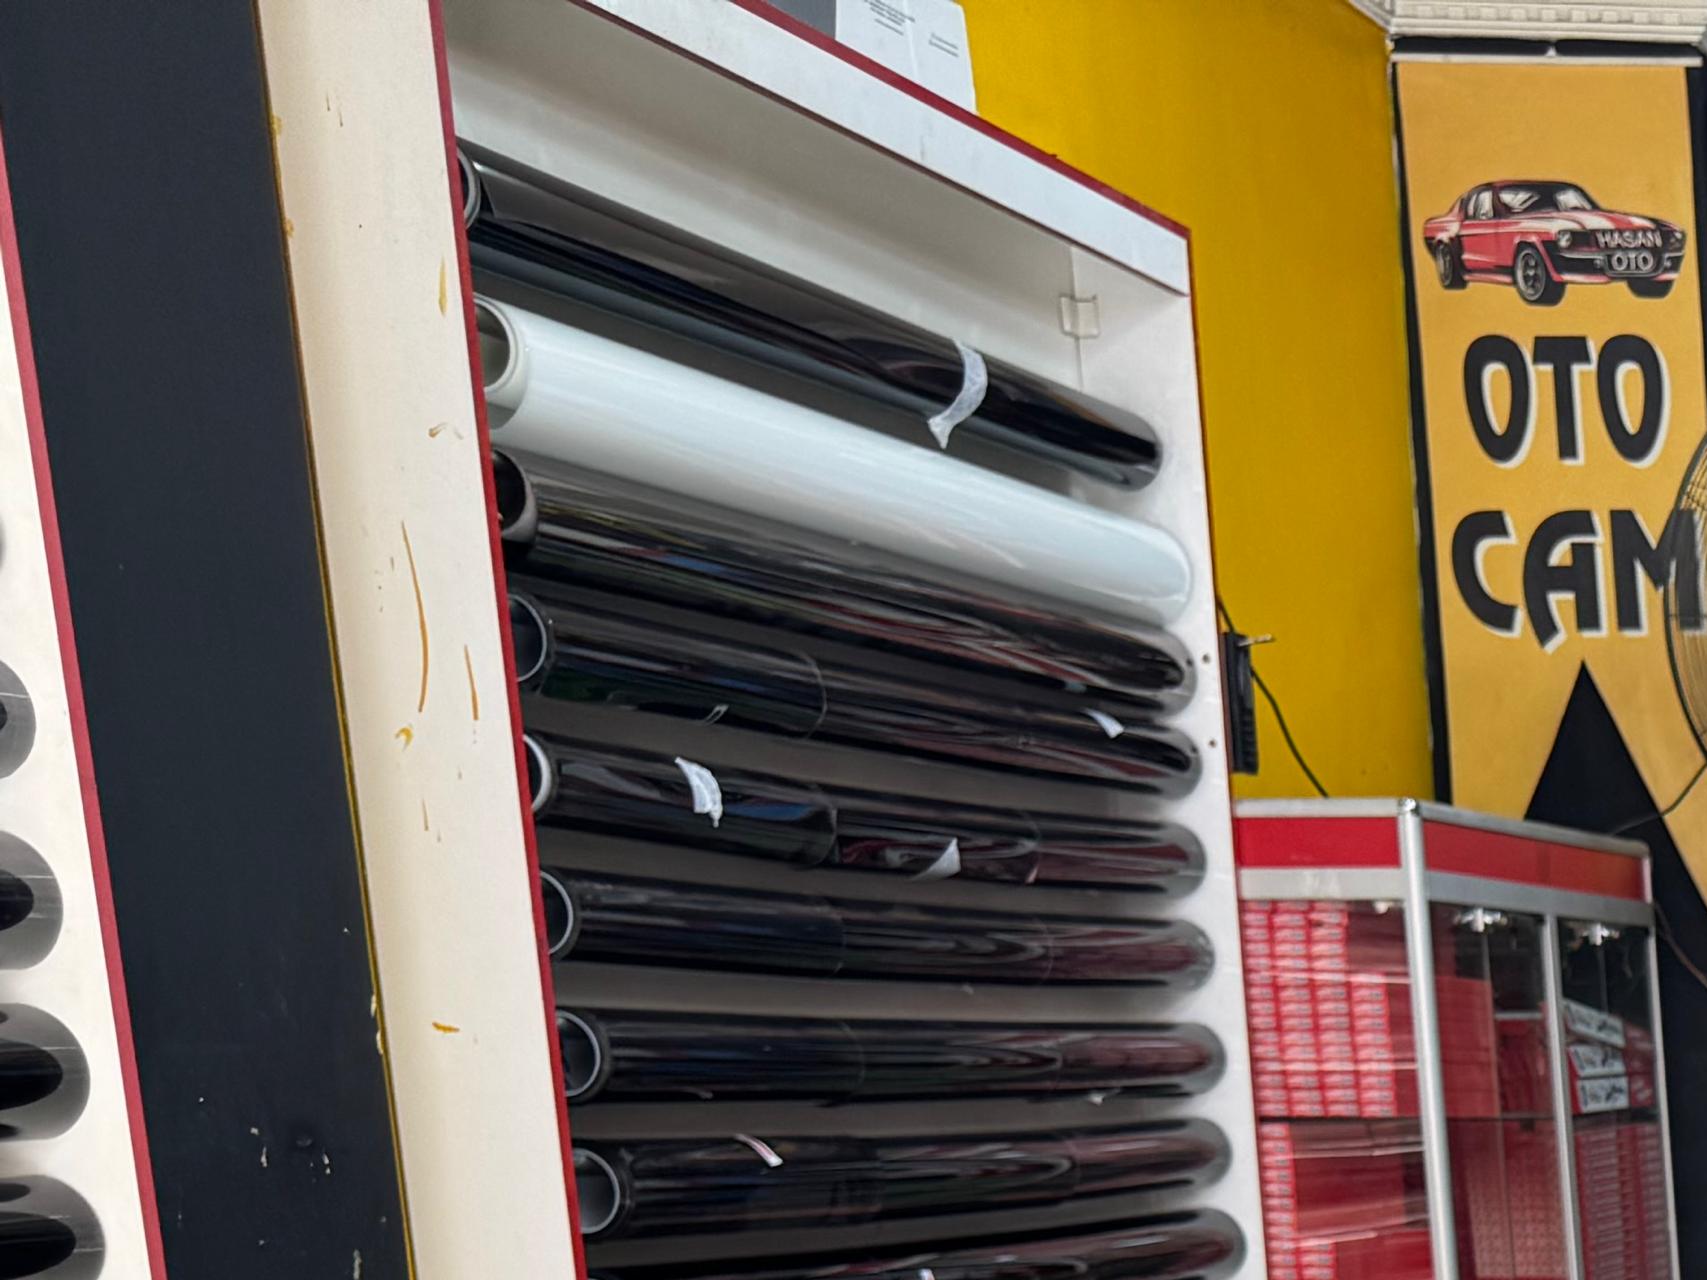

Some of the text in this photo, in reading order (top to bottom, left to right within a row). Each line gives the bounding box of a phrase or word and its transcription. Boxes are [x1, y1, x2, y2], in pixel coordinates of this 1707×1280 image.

[1596, 229, 1663, 249] HASAN
[1610, 252, 1653, 272] OTO
[1463, 334, 1671, 469] OTO
